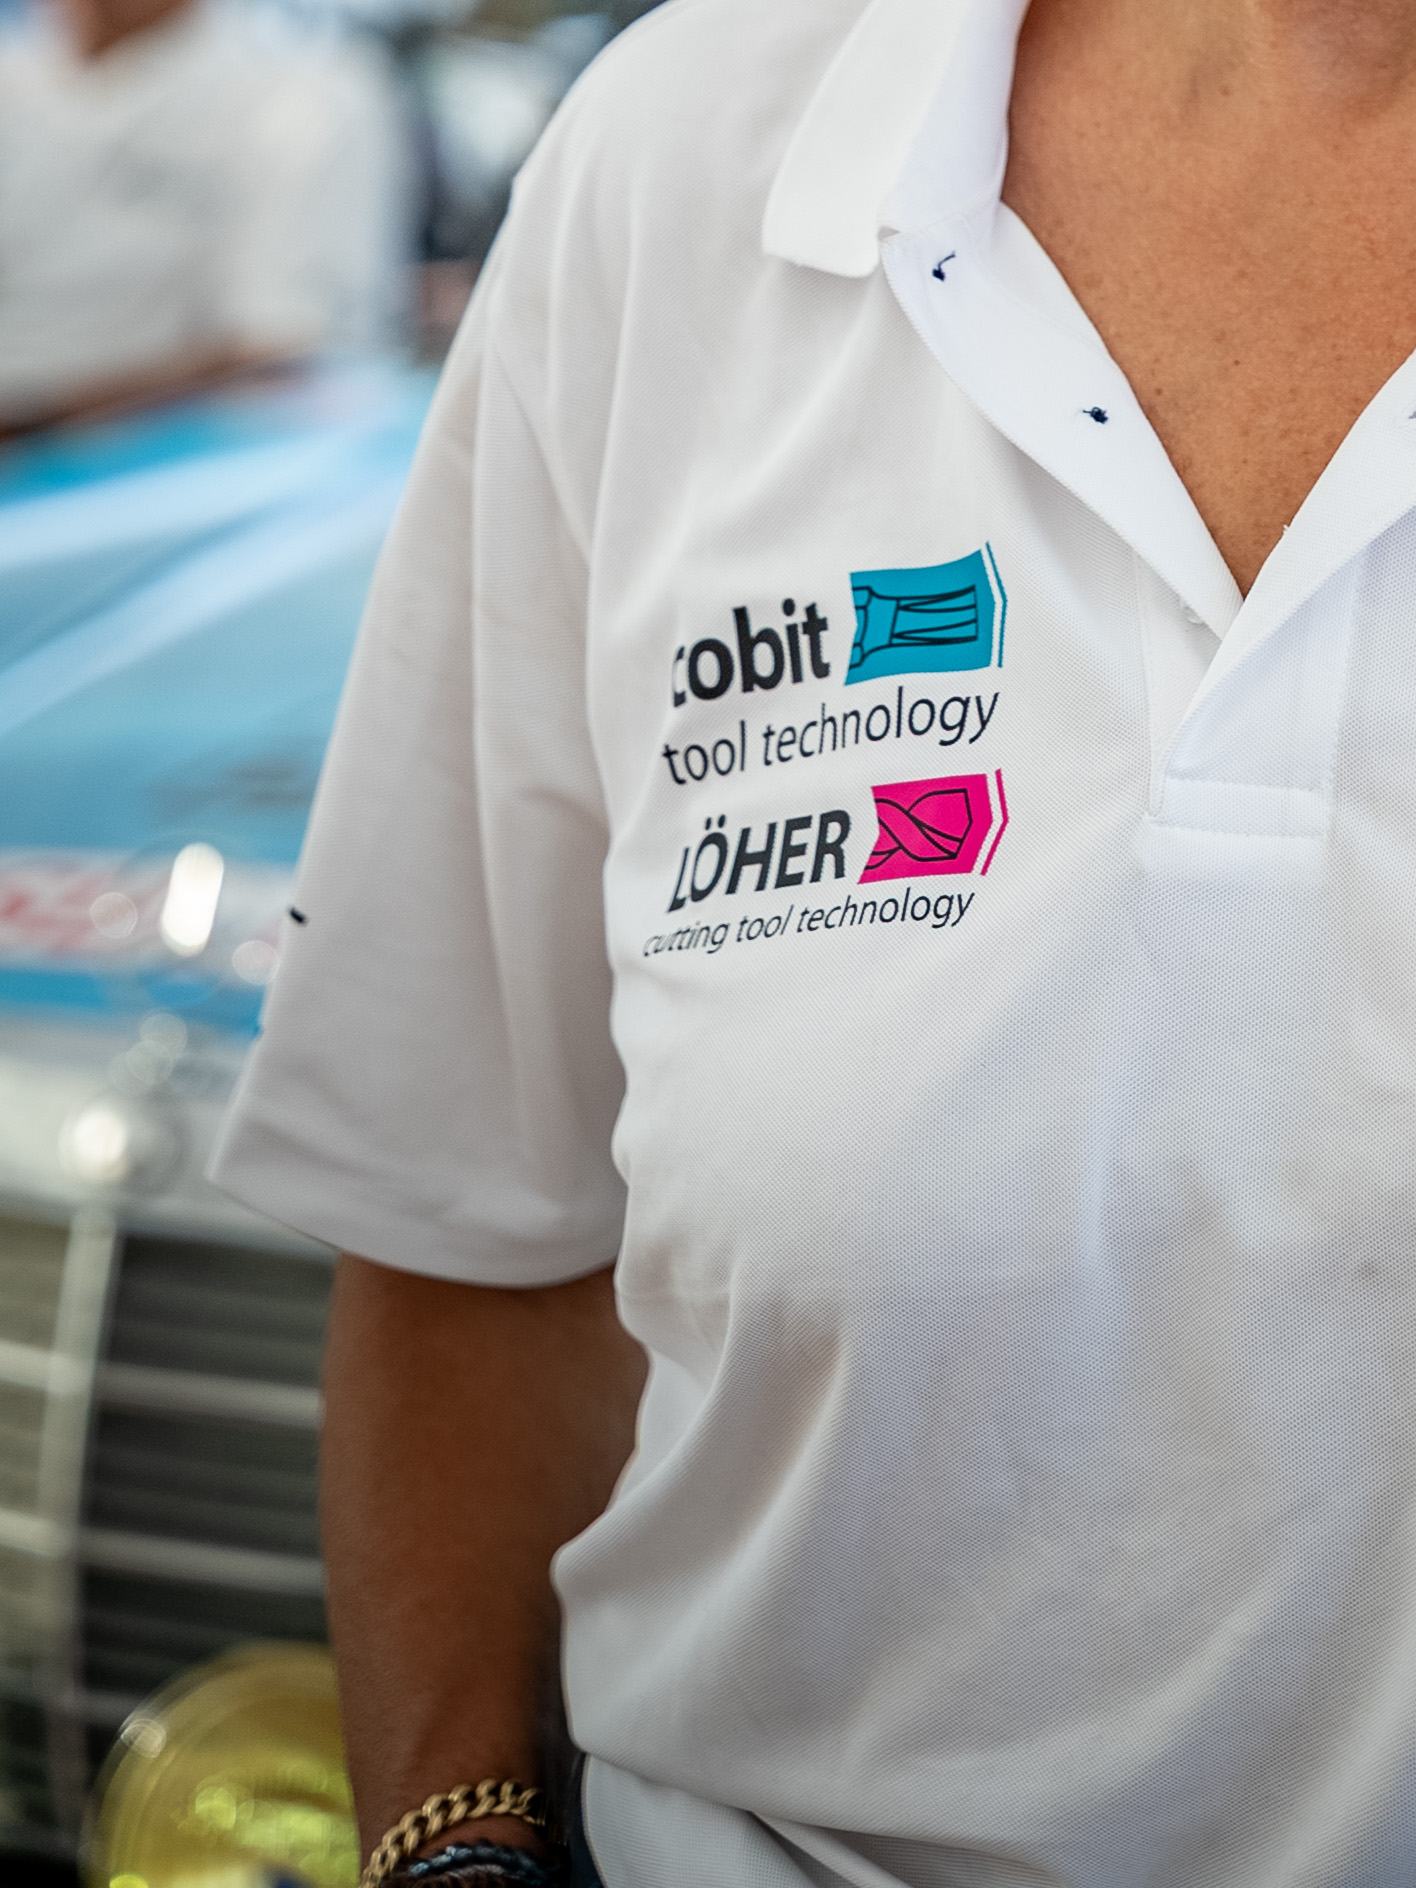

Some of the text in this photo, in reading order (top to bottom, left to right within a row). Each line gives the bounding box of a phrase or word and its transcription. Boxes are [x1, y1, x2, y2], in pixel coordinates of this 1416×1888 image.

[662, 685, 1000, 786] tool technology
[665, 809, 852, 914] LÖHER
[642, 886, 976, 956] cutting tool technology
